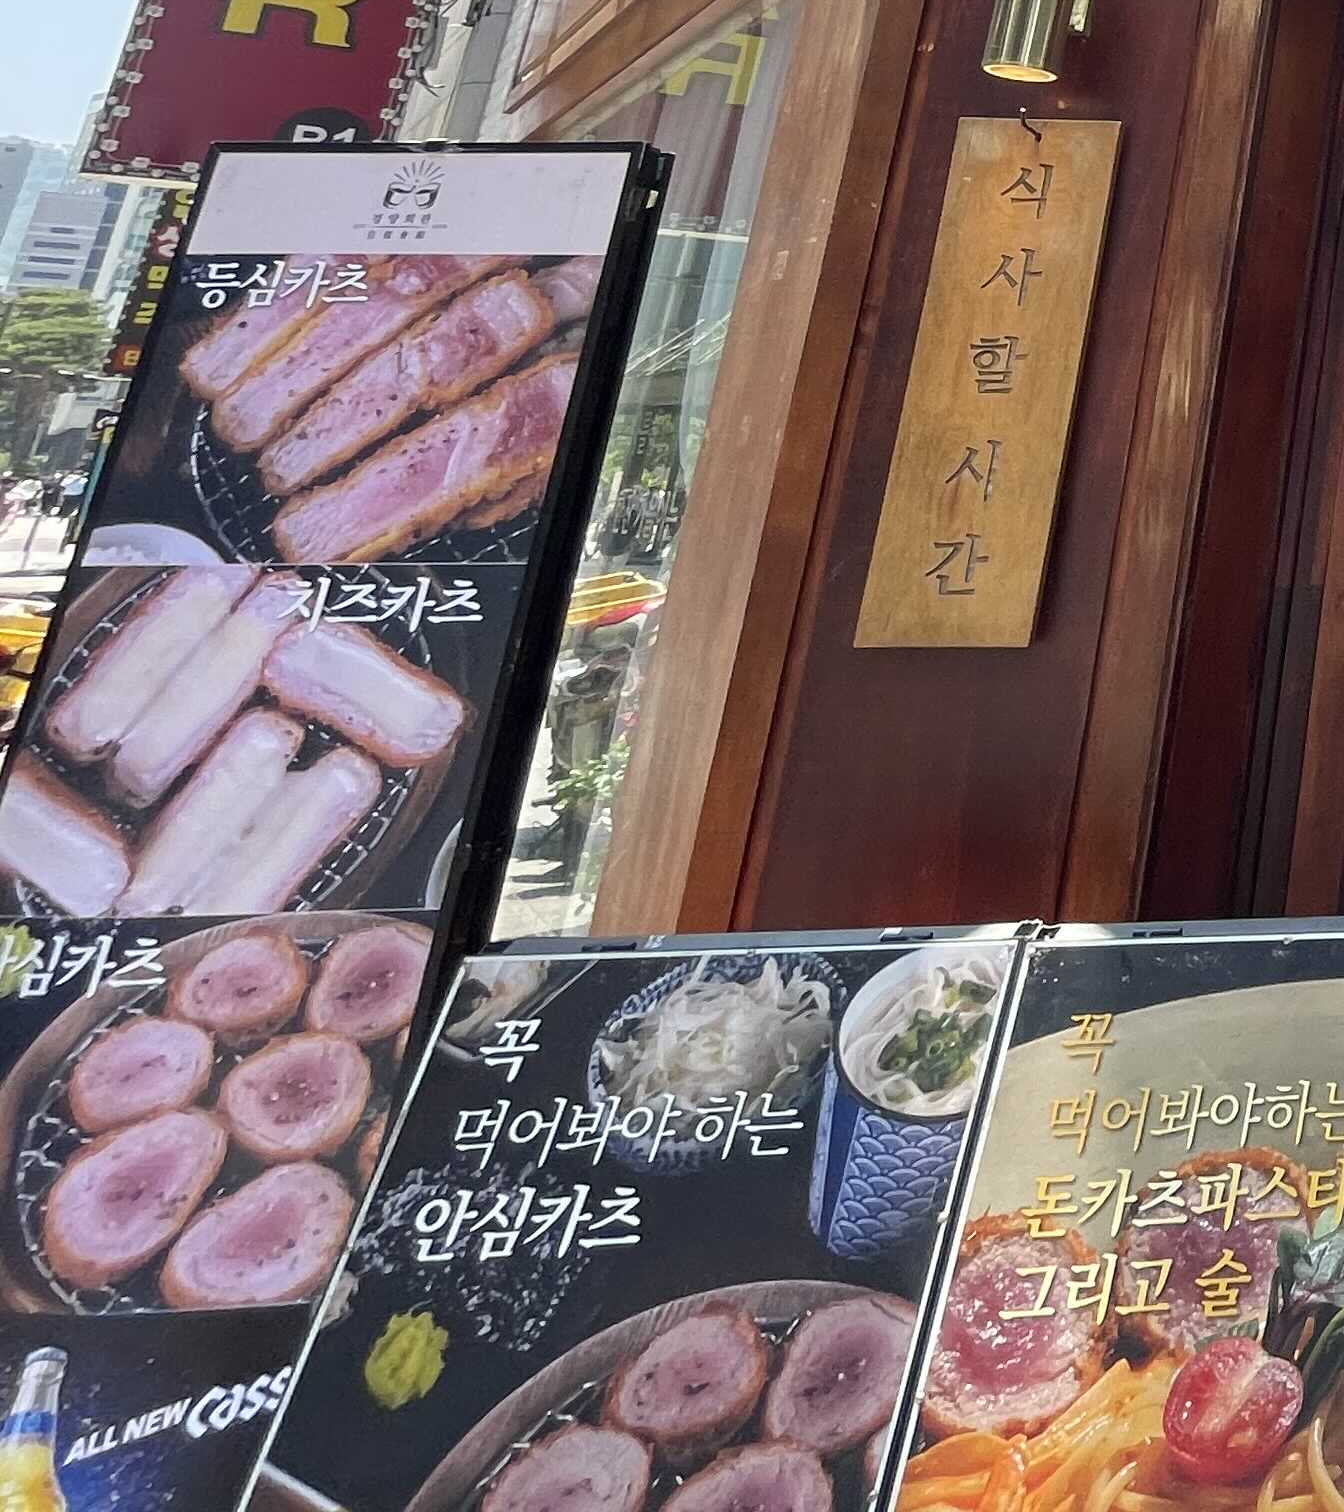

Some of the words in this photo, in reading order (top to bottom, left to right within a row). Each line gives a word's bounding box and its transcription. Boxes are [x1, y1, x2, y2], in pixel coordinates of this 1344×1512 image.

[196, 259, 369, 309] 등심카츠
[969, 162, 1054, 395] 식사할
[924, 439, 1003, 597] 시간
[278, 576, 486, 632] 치즈카츠
[479, 1018, 543, 1083] 꼭
[1061, 1011, 1115, 1074] 꼭
[454, 1092, 682, 1171] 먹어봐야
[694, 1090, 804, 1161] 하는
[413, 1183, 642, 1263] 안심카츠
[998, 1249, 1172, 1326] 그리고
[1194, 1248, 1254, 1321] 술
[61, 1424, 119, 1468] ALL
[120, 1396, 193, 1445] NEW
